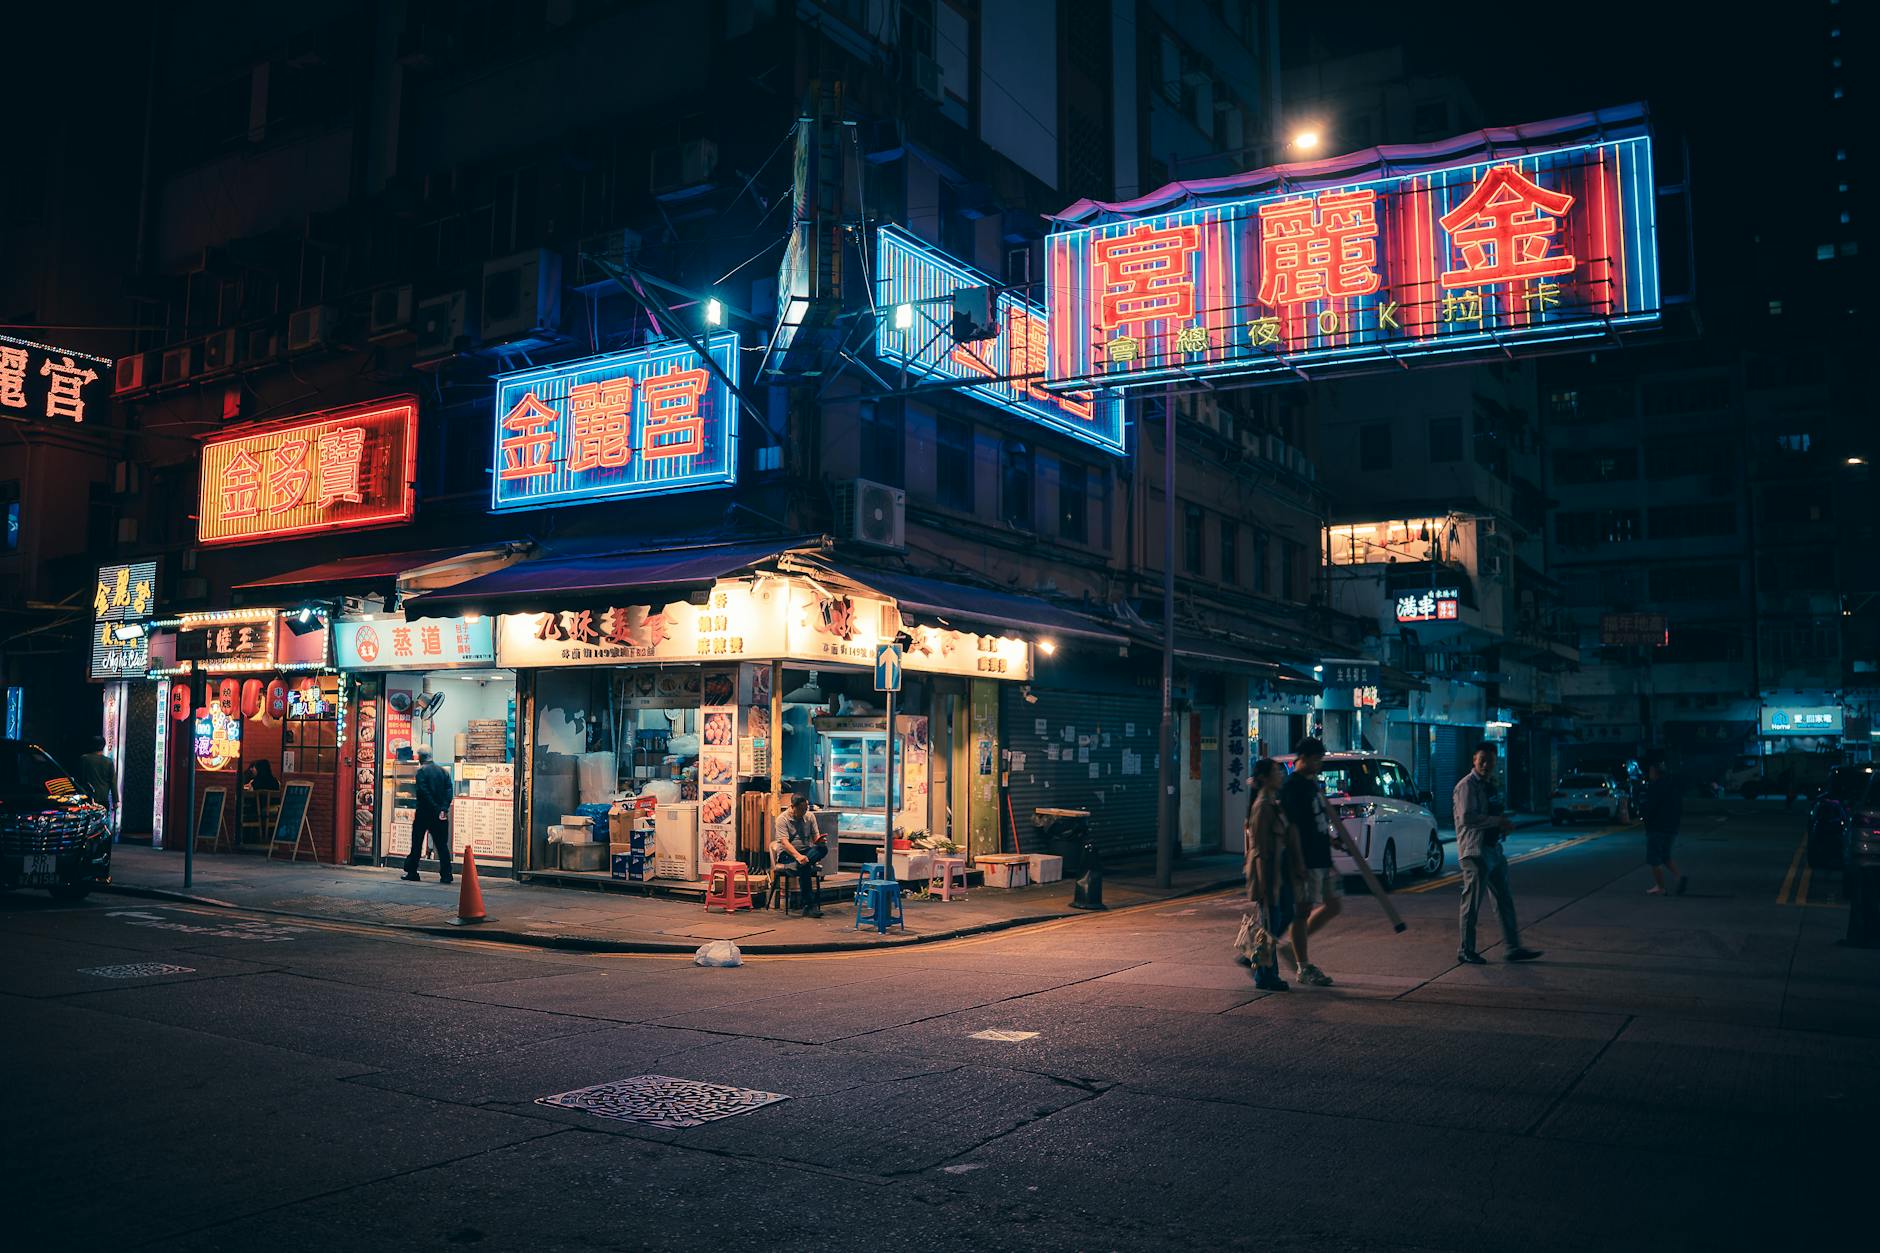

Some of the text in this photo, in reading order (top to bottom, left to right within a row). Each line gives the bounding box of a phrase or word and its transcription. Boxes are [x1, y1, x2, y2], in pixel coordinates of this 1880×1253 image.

[500, 367, 711, 481] 金麗宮
[220, 425, 367, 521] 金多寶
[207, 627, 254, 654] 燒王
[392, 625, 442, 657] 蒸道
